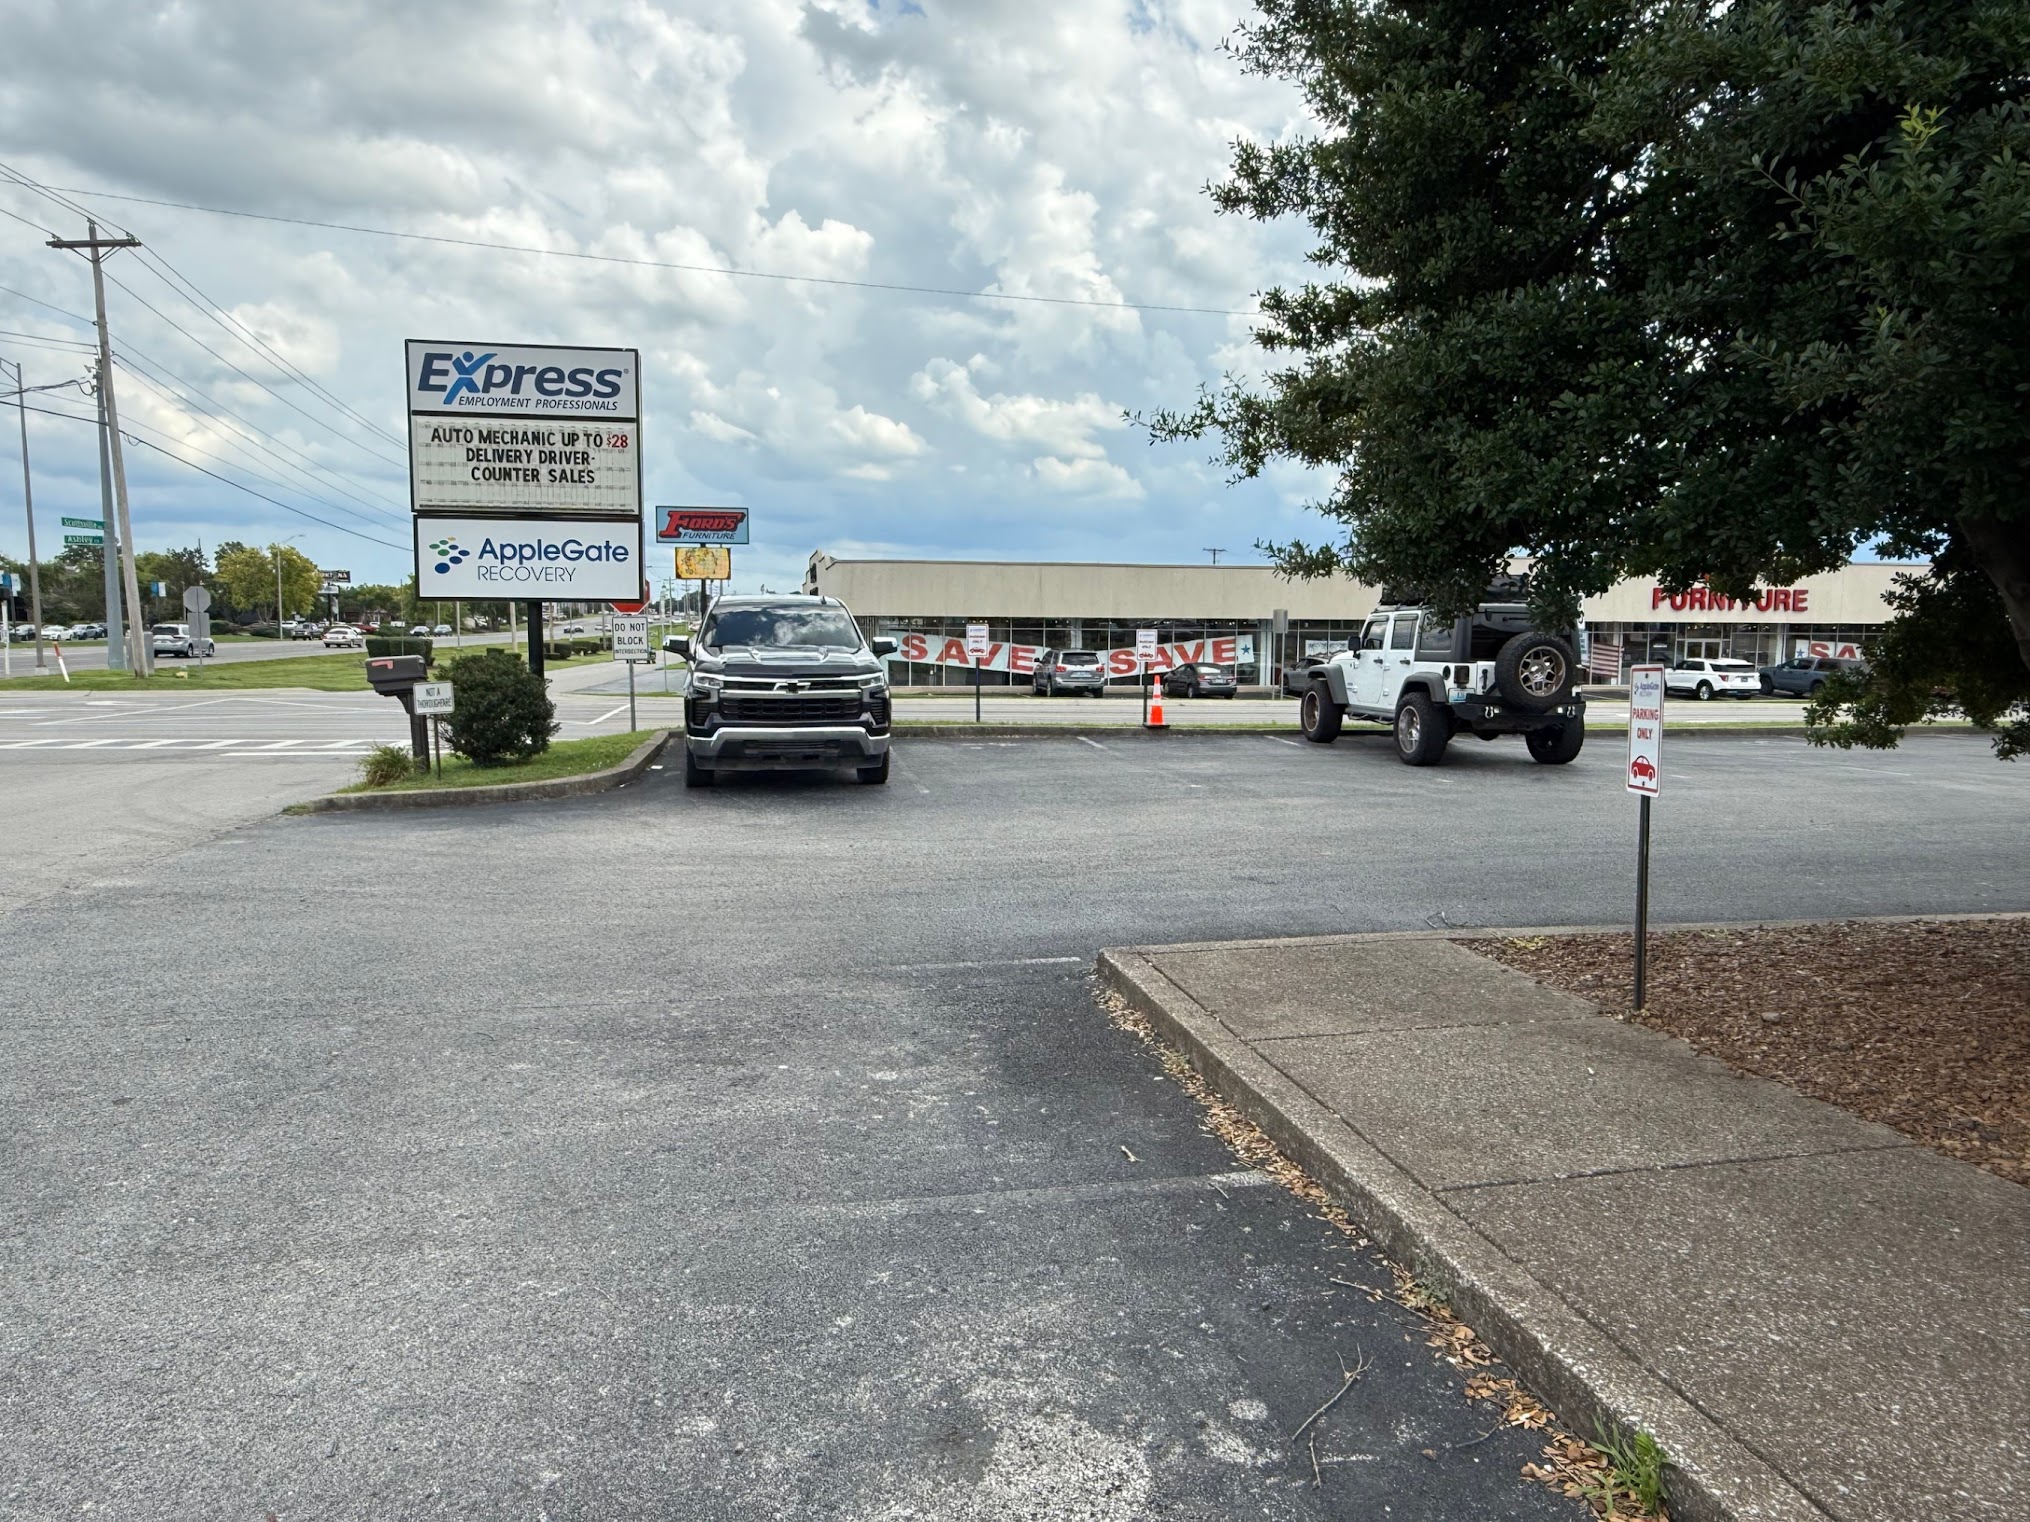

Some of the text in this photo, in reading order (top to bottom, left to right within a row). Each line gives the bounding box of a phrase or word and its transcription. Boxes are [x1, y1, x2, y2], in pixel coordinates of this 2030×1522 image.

[458, 396, 618, 411] EMPLOYMENT PROFESSIONALS
[431, 428, 628, 448] AUTO MECHANIC UP TO $28
[466, 448, 533, 464] DELIVERY
[471, 467, 595, 484] COUNTER SALES
[682, 531, 736, 540] FURNITURE
[478, 538, 629, 565] AppleGate
[477, 565, 576, 582] RECOVERY
[614, 623, 645, 632] DO NOT
[617, 636, 644, 645] BLOCK
[900, 635, 1036, 672] SAVE
[1109, 638, 1237, 675] SAVE
[1633, 708, 1659, 720] PARKING
[1637, 728, 1653, 740] ONLY
